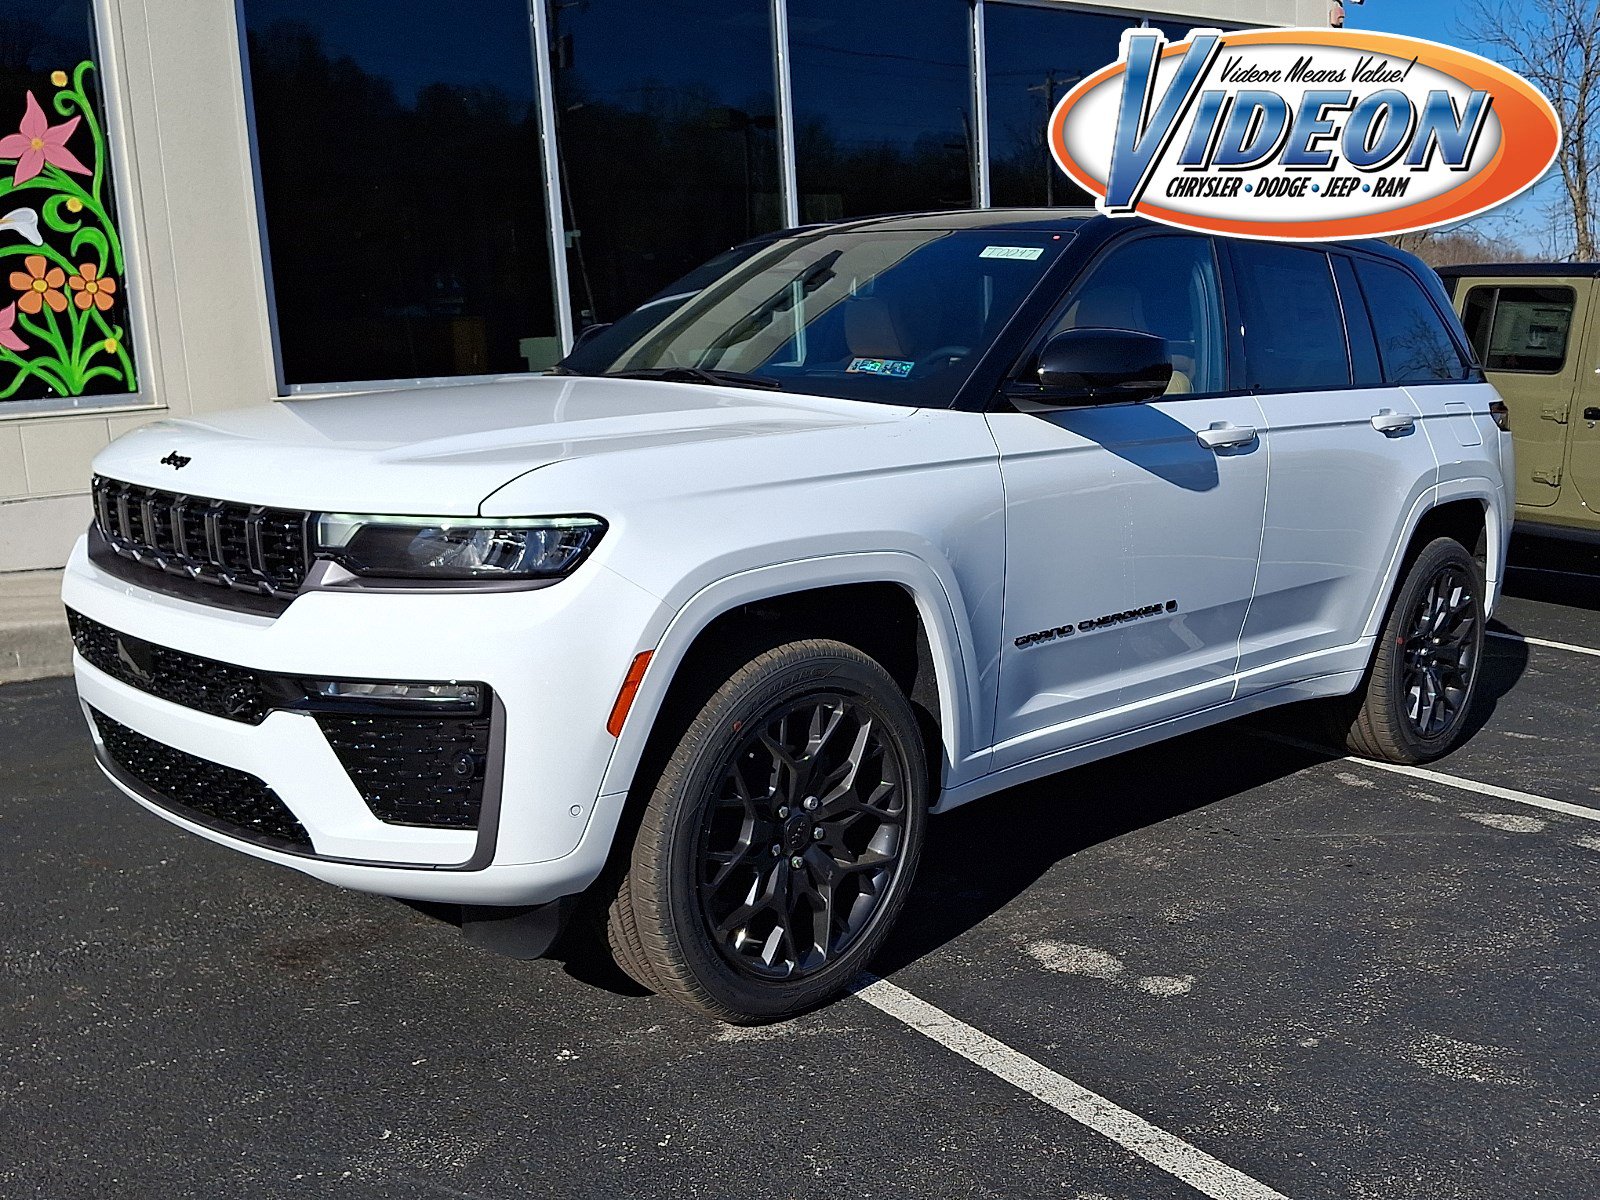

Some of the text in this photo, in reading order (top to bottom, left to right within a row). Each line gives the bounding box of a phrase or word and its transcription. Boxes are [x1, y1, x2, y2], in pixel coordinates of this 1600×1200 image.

[160, 450, 192, 470] Jeep
[1014, 602, 1164, 650] GRAND CHEROKEE
